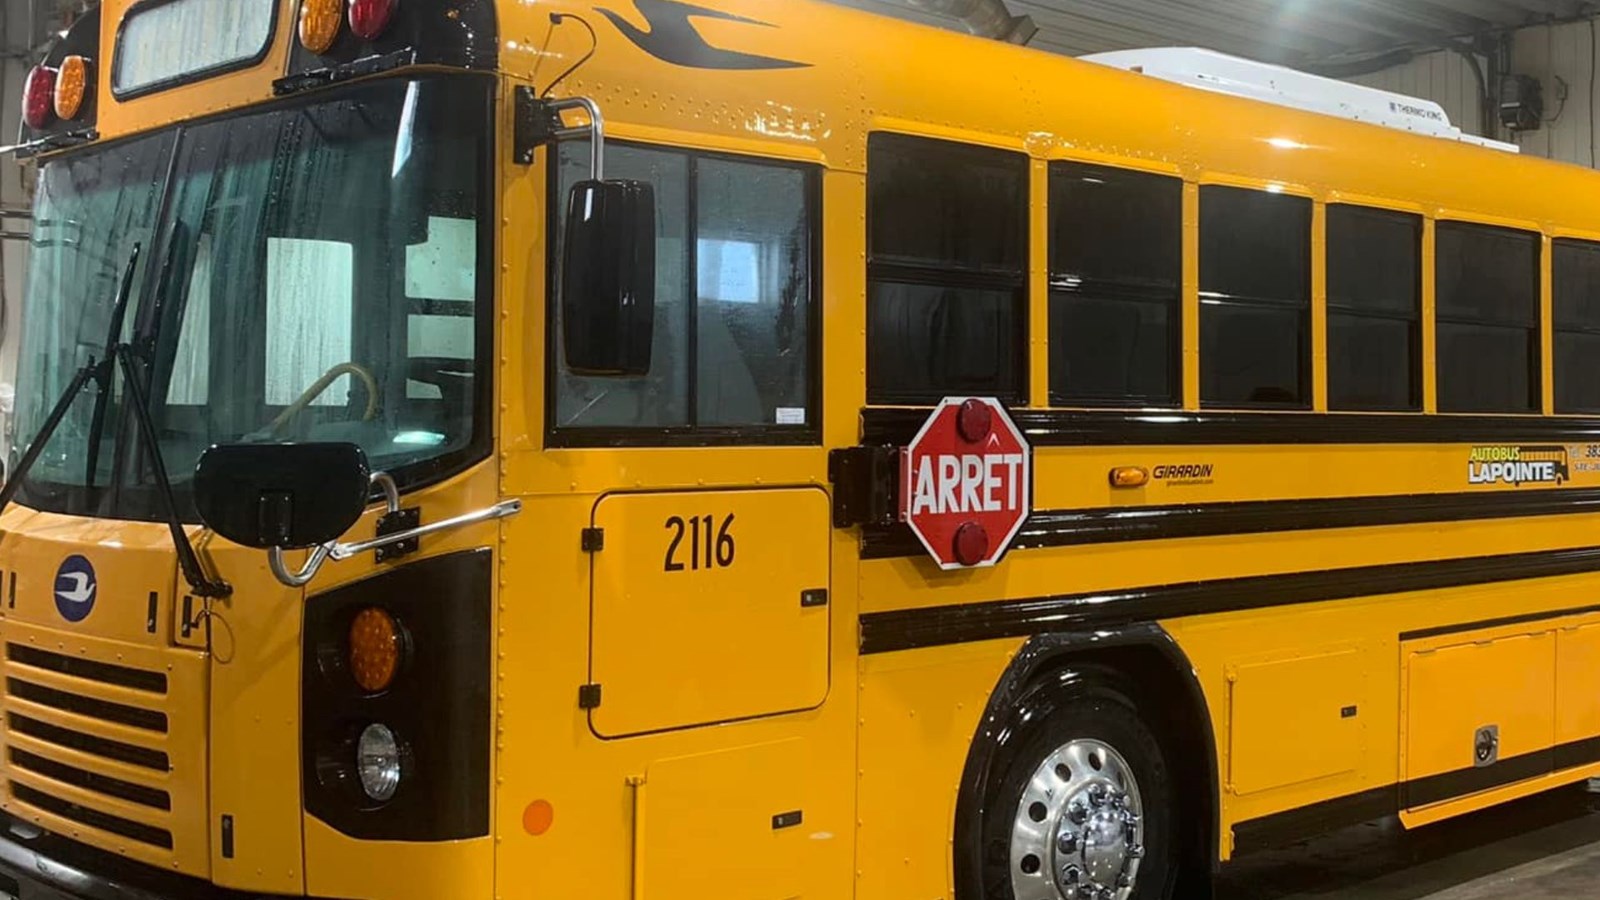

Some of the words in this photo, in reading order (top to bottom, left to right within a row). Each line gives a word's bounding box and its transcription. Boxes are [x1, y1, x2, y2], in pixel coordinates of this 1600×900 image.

[1397, 103, 1425, 118] THERMO
[1470, 446, 1520, 461] AUTOBUS
[1153, 464, 1213, 479] GIRARDIN
[1468, 461, 1555, 483] LAPOINTE
[664, 512, 735, 571] 2116
